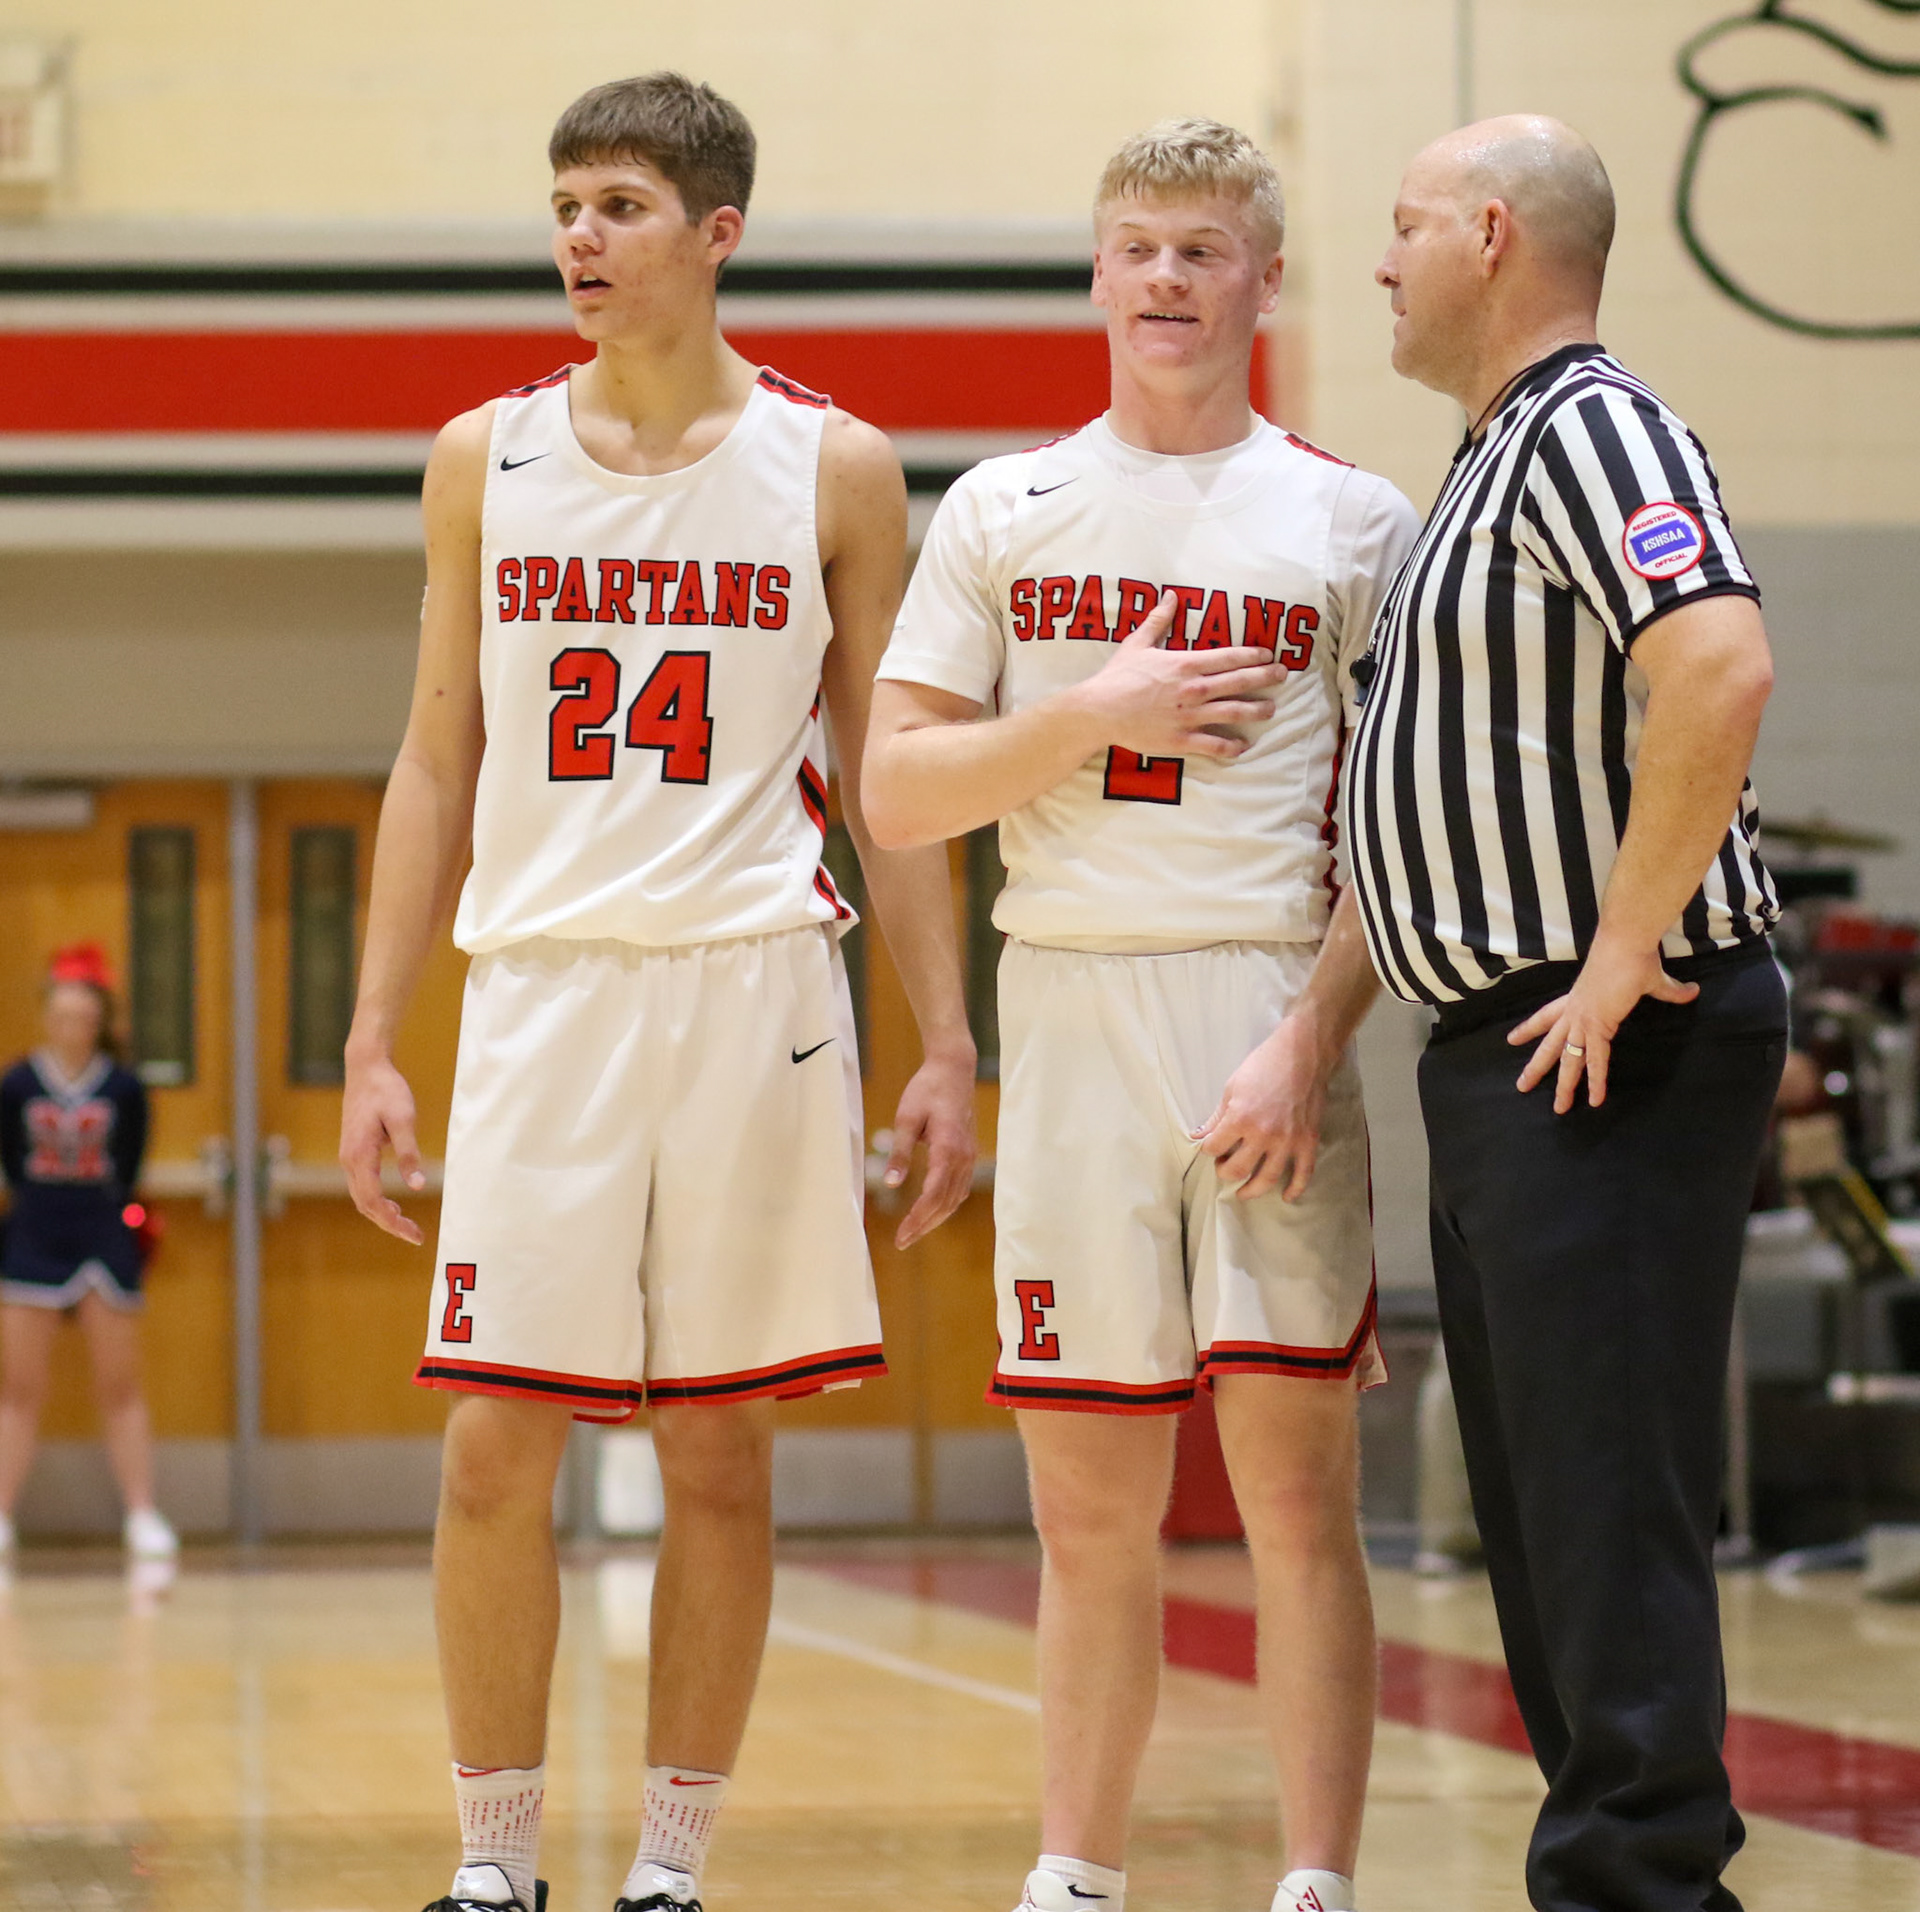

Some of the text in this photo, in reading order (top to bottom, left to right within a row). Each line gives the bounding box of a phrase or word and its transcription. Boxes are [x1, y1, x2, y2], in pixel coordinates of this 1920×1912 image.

[1632, 511, 1677, 532] REGISTERED
[1641, 528, 1686, 553] KSHSAA
[497, 556, 791, 630] SPARTANS
[1655, 553, 1688, 568] OFFICIAL
[1010, 575, 1320, 671] SPARTANS
[548, 647, 714, 785] 24
[441, 1263, 477, 1343] E
[1014, 1279, 1060, 1361] E
